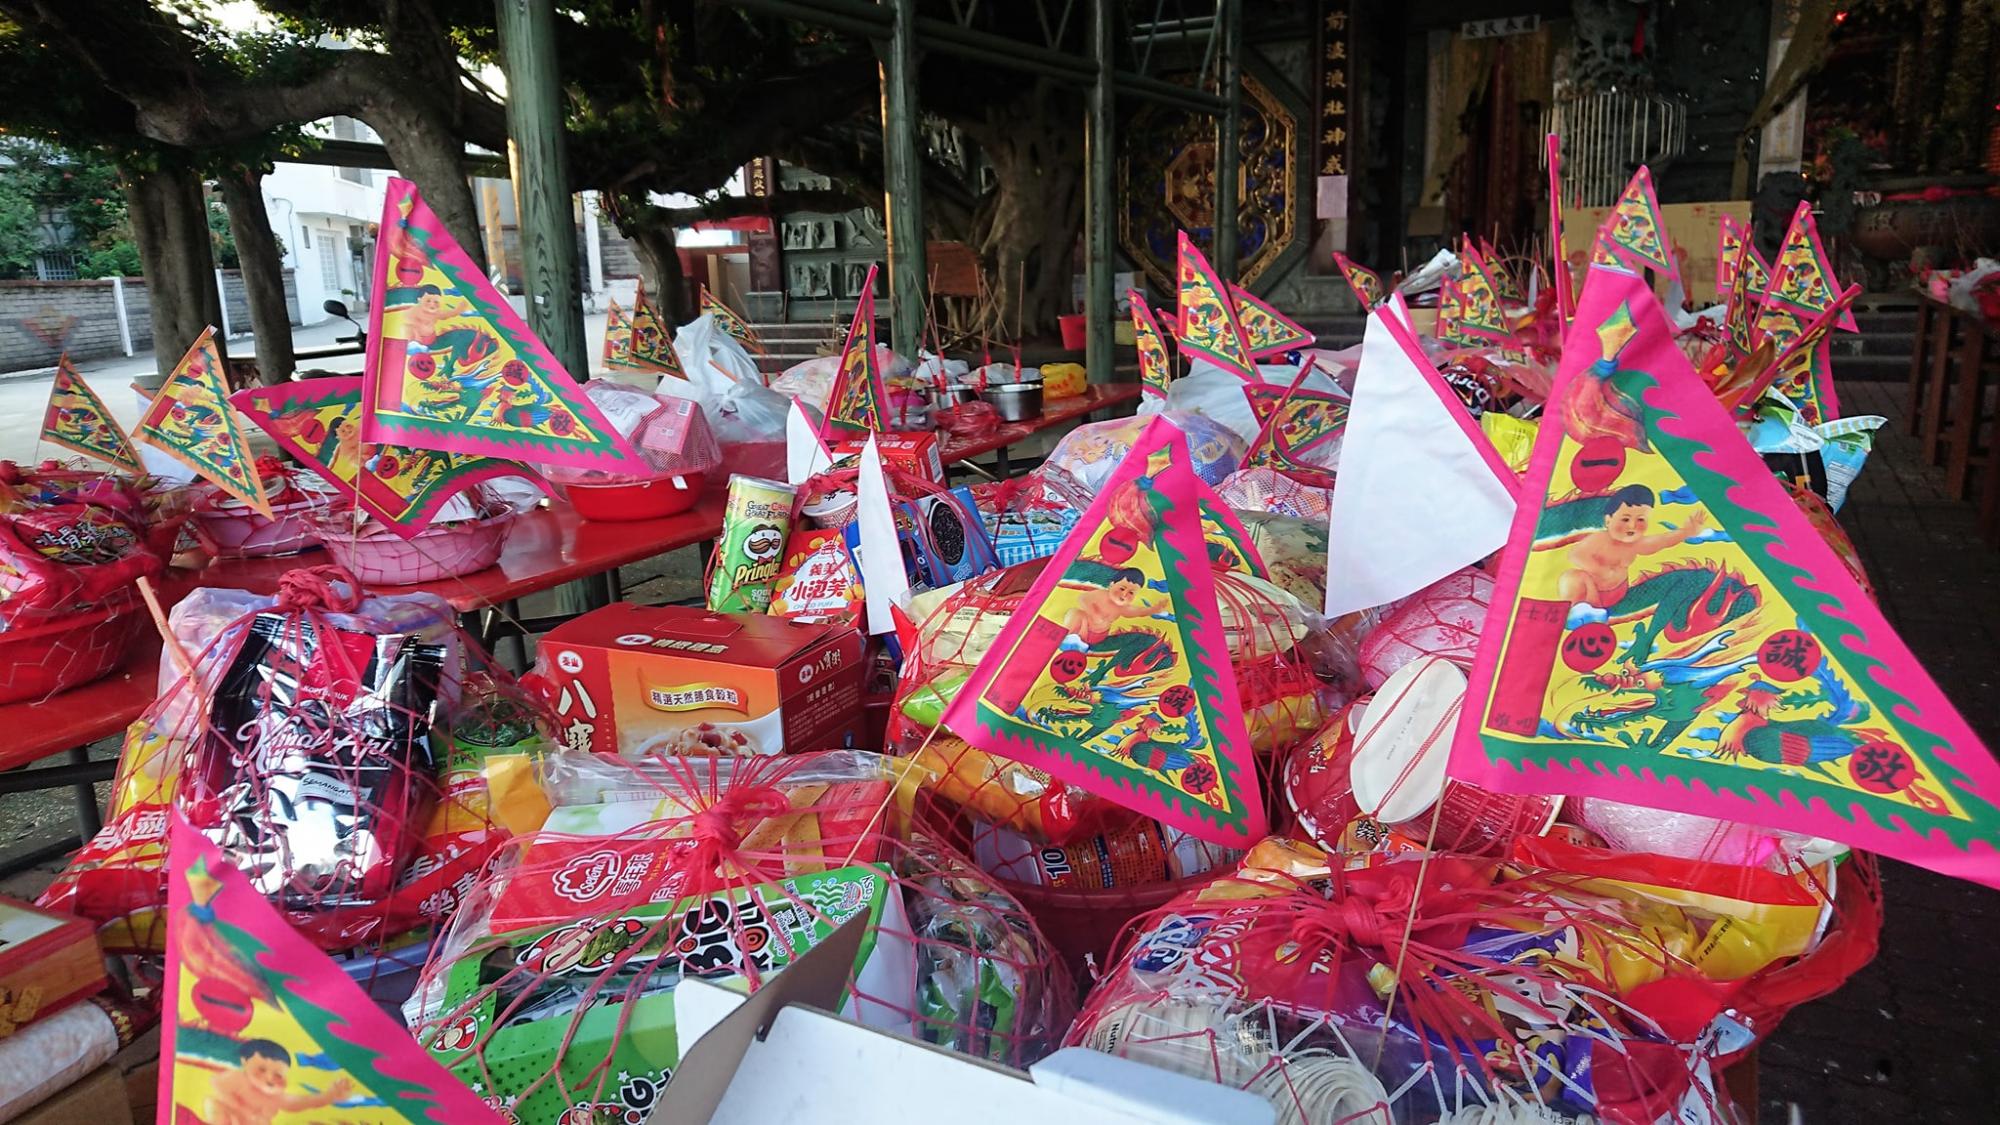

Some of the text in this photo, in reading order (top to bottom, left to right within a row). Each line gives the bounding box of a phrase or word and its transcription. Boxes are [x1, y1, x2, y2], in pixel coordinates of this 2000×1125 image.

[793, 579, 848, 602] 小泡芙
[1564, 633, 1612, 660] 心
[1764, 635, 1815, 681] 誠
[1053, 657, 1083, 677] 心
[1163, 686, 1194, 716] 誠
[1856, 751, 1907, 795] 敬
